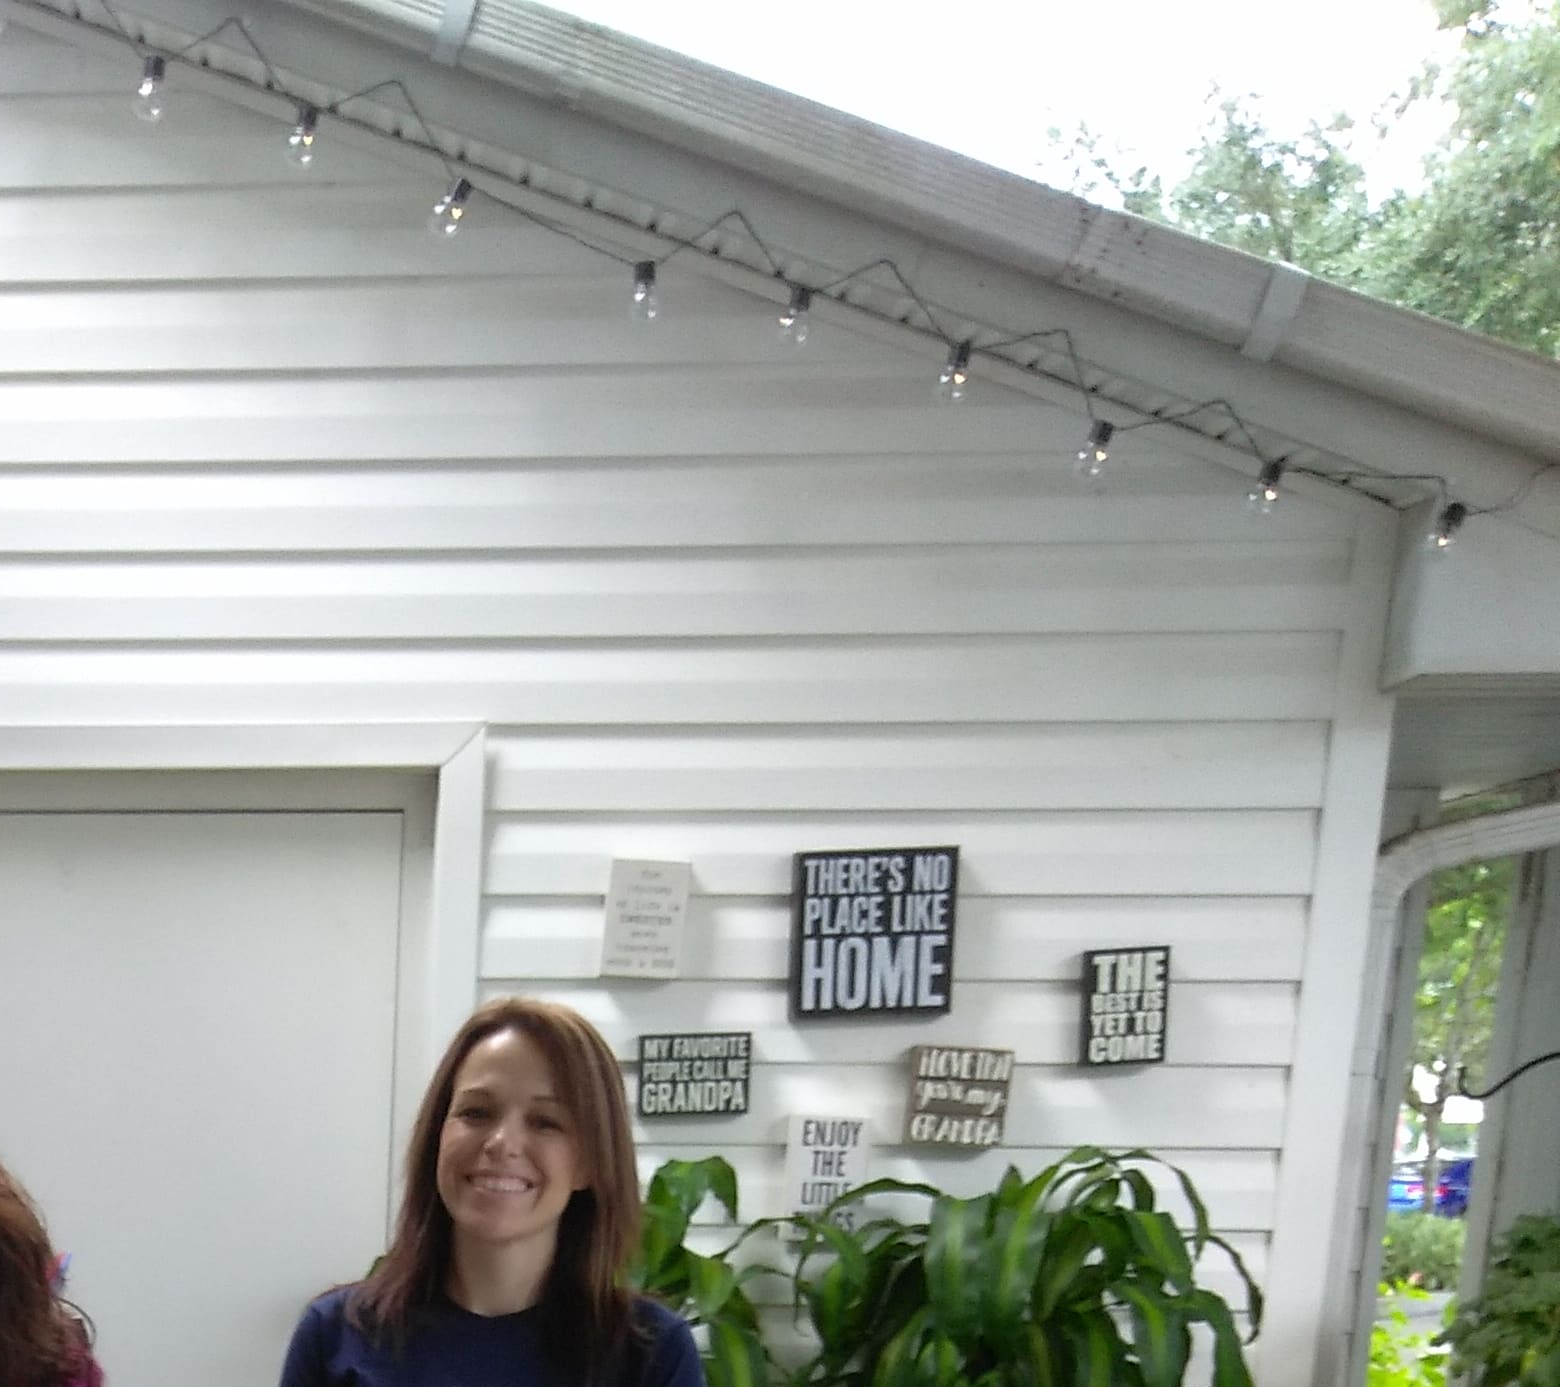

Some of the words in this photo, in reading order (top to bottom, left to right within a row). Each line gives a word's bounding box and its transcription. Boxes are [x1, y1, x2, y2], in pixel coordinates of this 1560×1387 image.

[804, 856, 907, 895] THERE'S
[913, 854, 952, 892] NO
[804, 895, 885, 935] PLACE
[891, 893, 950, 932] LIKE
[801, 934, 948, 1010] HOME
[1092, 951, 1165, 993] THE
[1091, 1012, 1130, 1036] YET
[1134, 1010, 1162, 1034] TO
[643, 1038, 671, 1059] MY
[672, 1036, 748, 1058] FAVORITE
[1089, 1034, 1162, 1063] COME
[643, 1061, 692, 1081] PEOPLE
[692, 1060, 725, 1080] CALL
[727, 1059, 748, 1080] ME
[642, 1080, 747, 1114] GRANDPA
[802, 1119, 863, 1147] ENJOY
[812, 1150, 848, 1177] THE
